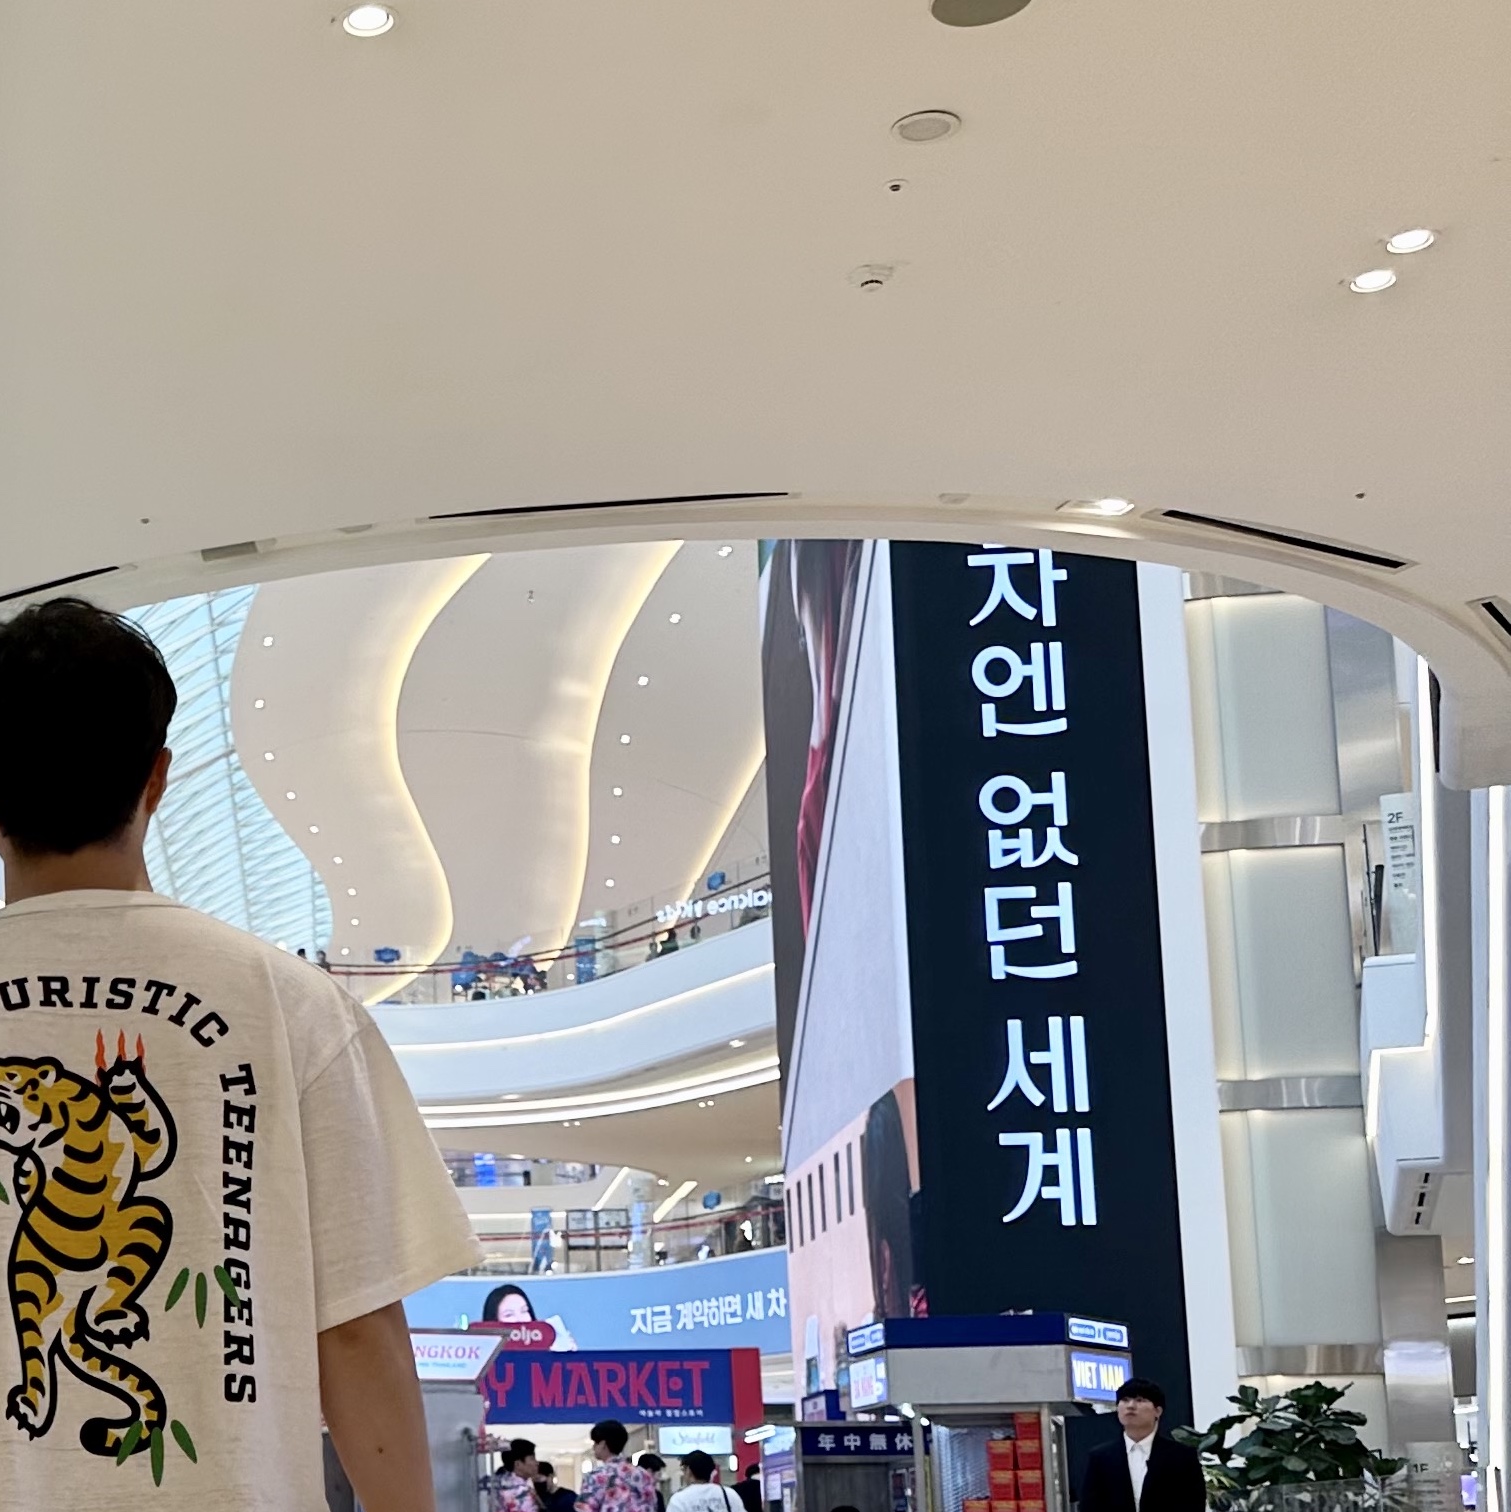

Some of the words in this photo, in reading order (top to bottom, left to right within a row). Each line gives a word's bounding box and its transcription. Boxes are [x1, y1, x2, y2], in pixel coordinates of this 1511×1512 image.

[1387, 811, 1404, 824] 2F
[979, 771, 1079, 980] 없던
[987, 1015, 1097, 1226] 세계
[218, 1062, 257, 1403] TEENAGERS
[630, 1304, 673, 1335] 지금
[675, 1293, 744, 1331] 계약하면
[746, 1290, 764, 1321] 새
[766, 1287, 788, 1318] 차
[531, 1361, 710, 1408] MARKET
[1071, 1360, 1098, 1390] VIET
